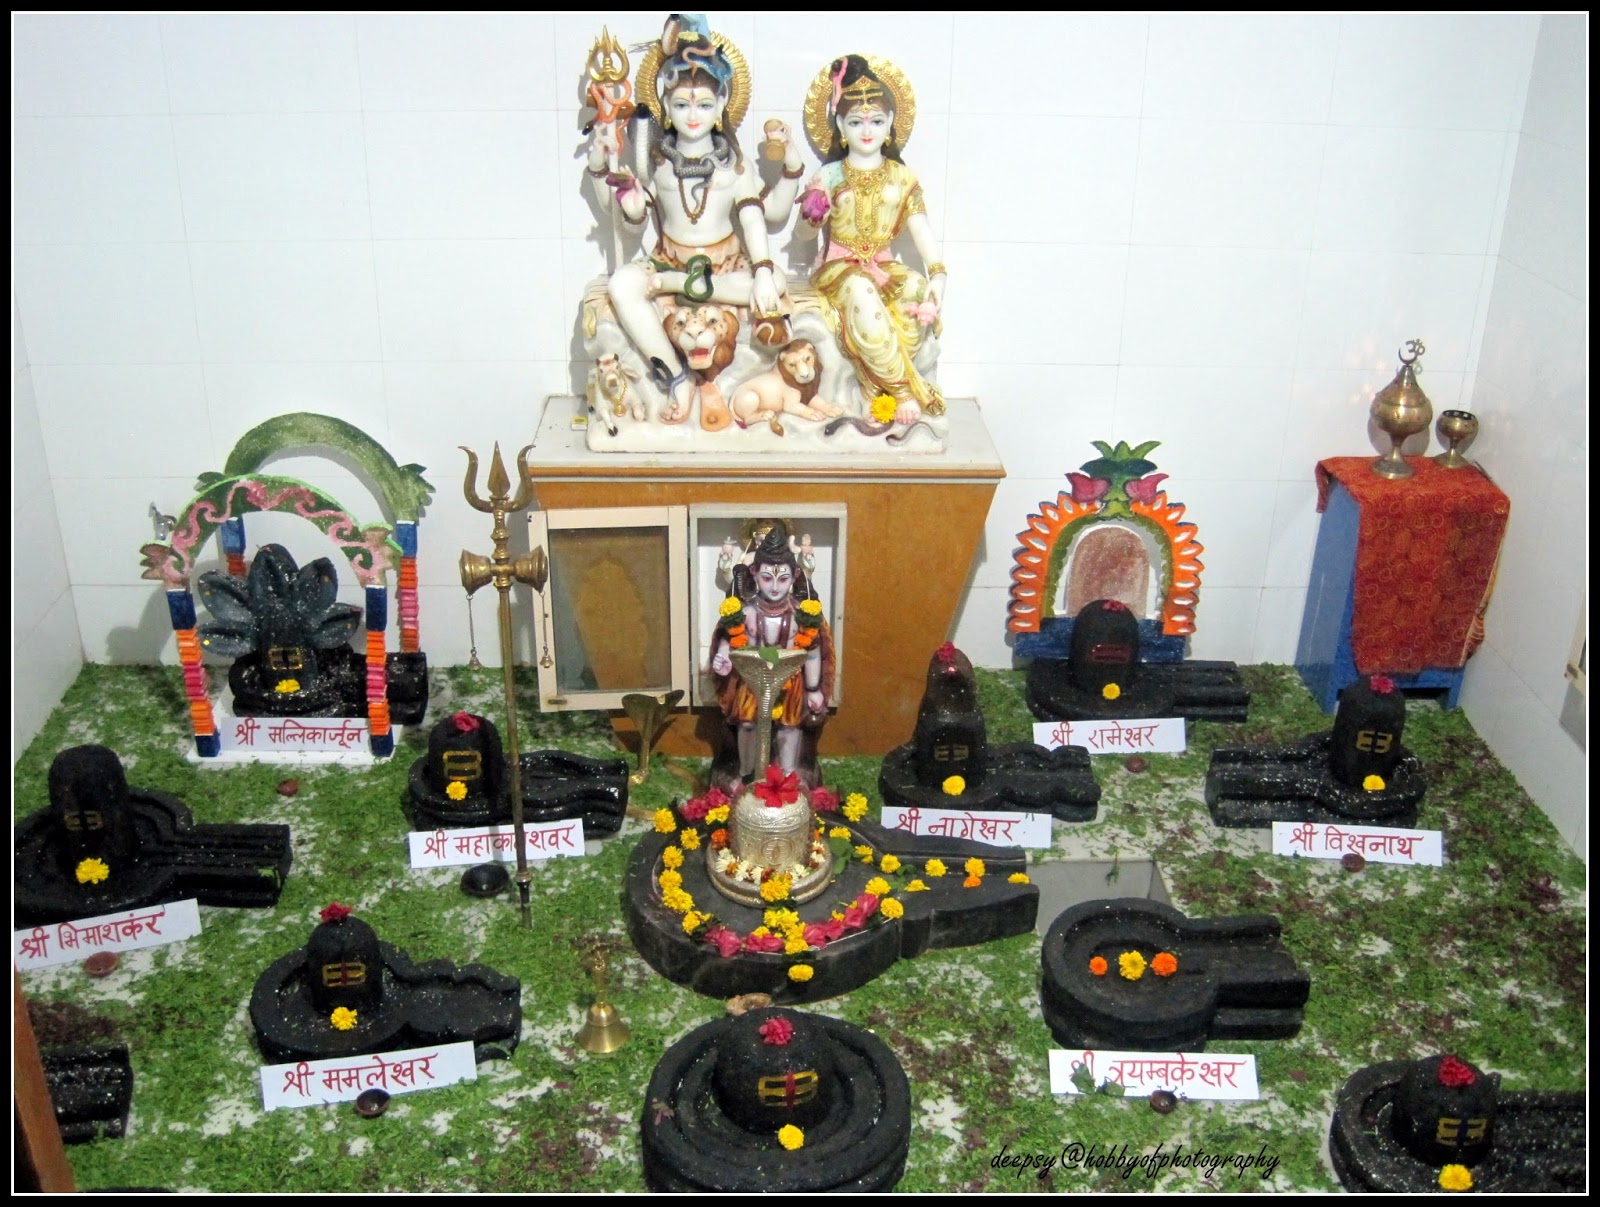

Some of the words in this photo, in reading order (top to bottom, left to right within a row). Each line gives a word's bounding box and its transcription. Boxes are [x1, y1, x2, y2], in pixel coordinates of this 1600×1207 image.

[235, 718, 261, 746] श्री
[1050, 721, 1074, 745] श्री
[1088, 721, 1160, 749] रामेश्वर
[895, 807, 922, 836] श्री
[928, 812, 1021, 841] नागेश्वर
[423, 829, 448, 859] श्री
[1289, 822, 1319, 852] श्री
[1324, 825, 1424, 860] विश्वनाथ
[19, 926, 50, 959] श्री
[282, 1061, 316, 1097] श्री
[322, 1053, 439, 1093] ममलेश्वर
